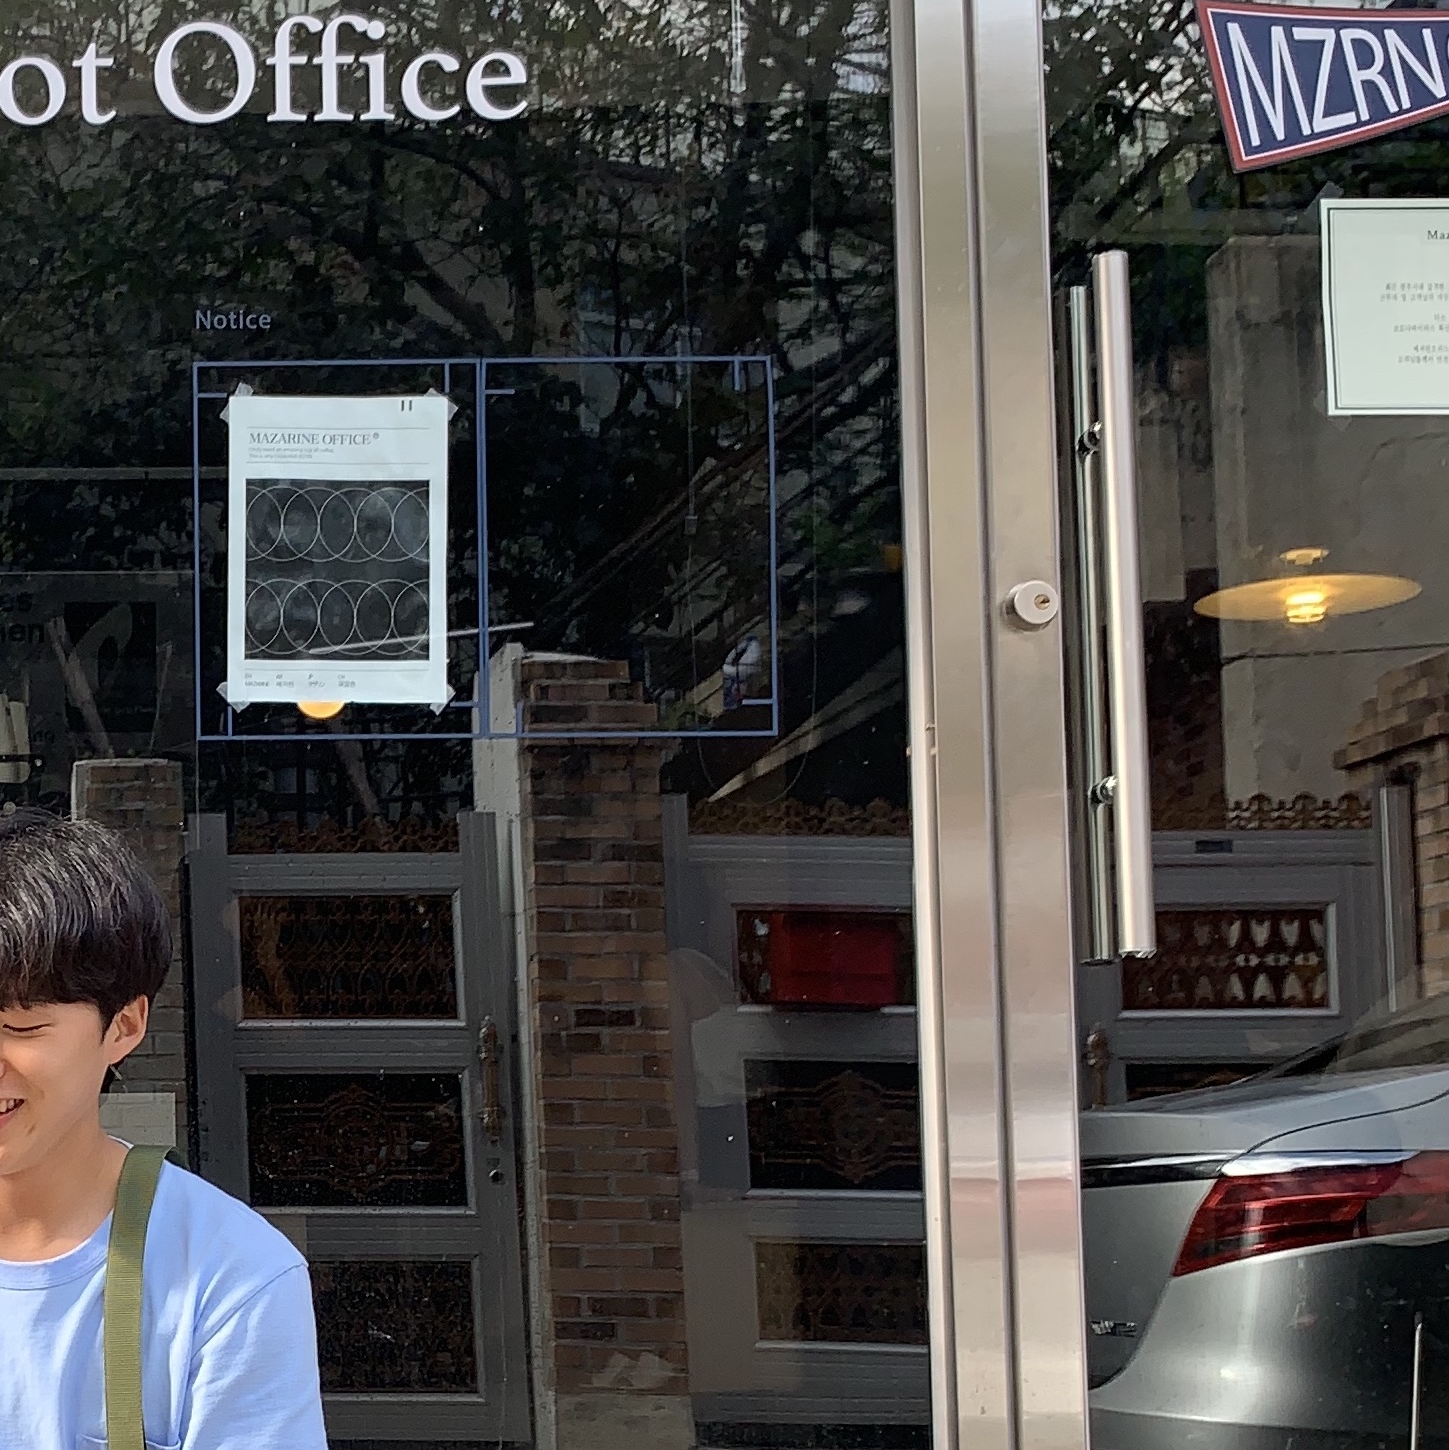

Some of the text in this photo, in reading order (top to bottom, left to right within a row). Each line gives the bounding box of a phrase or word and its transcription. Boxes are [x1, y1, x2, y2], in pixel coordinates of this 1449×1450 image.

[153, 13, 530, 126] Office
[1226, 20, 1448, 147] MZRN
[193, 308, 272, 331] Notice
[248, 432, 320, 445] MAZARINE
